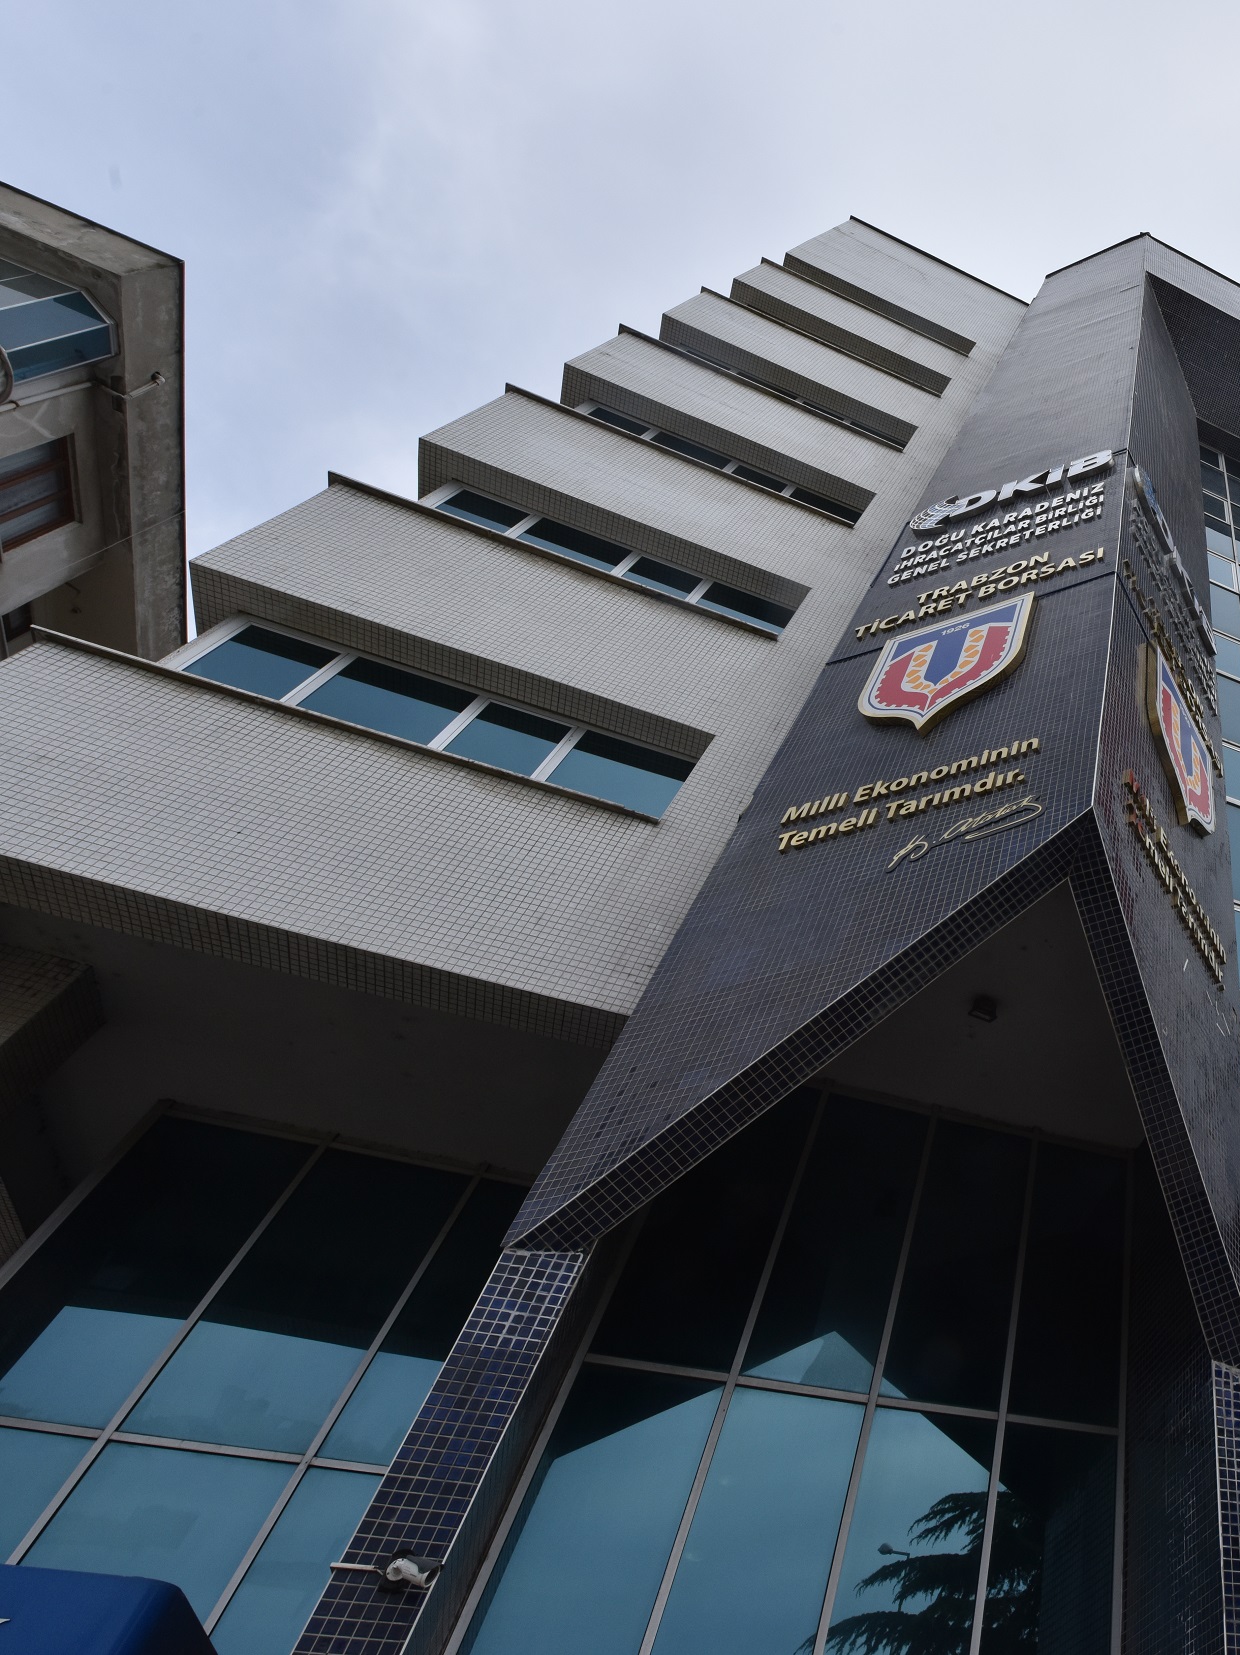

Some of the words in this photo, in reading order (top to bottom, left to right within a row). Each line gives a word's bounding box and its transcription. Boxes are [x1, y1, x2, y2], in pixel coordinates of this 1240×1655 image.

[900, 528, 966, 560] DOĞU
[855, 590, 975, 639] TİCARET
[977, 547, 1105, 600] BORSASI
[886, 558, 951, 585] GENEL
[916, 551, 1050, 605] TRABZON
[852, 736, 1040, 805] Ekonominin
[885, 768, 1026, 822] Tarımdır.
